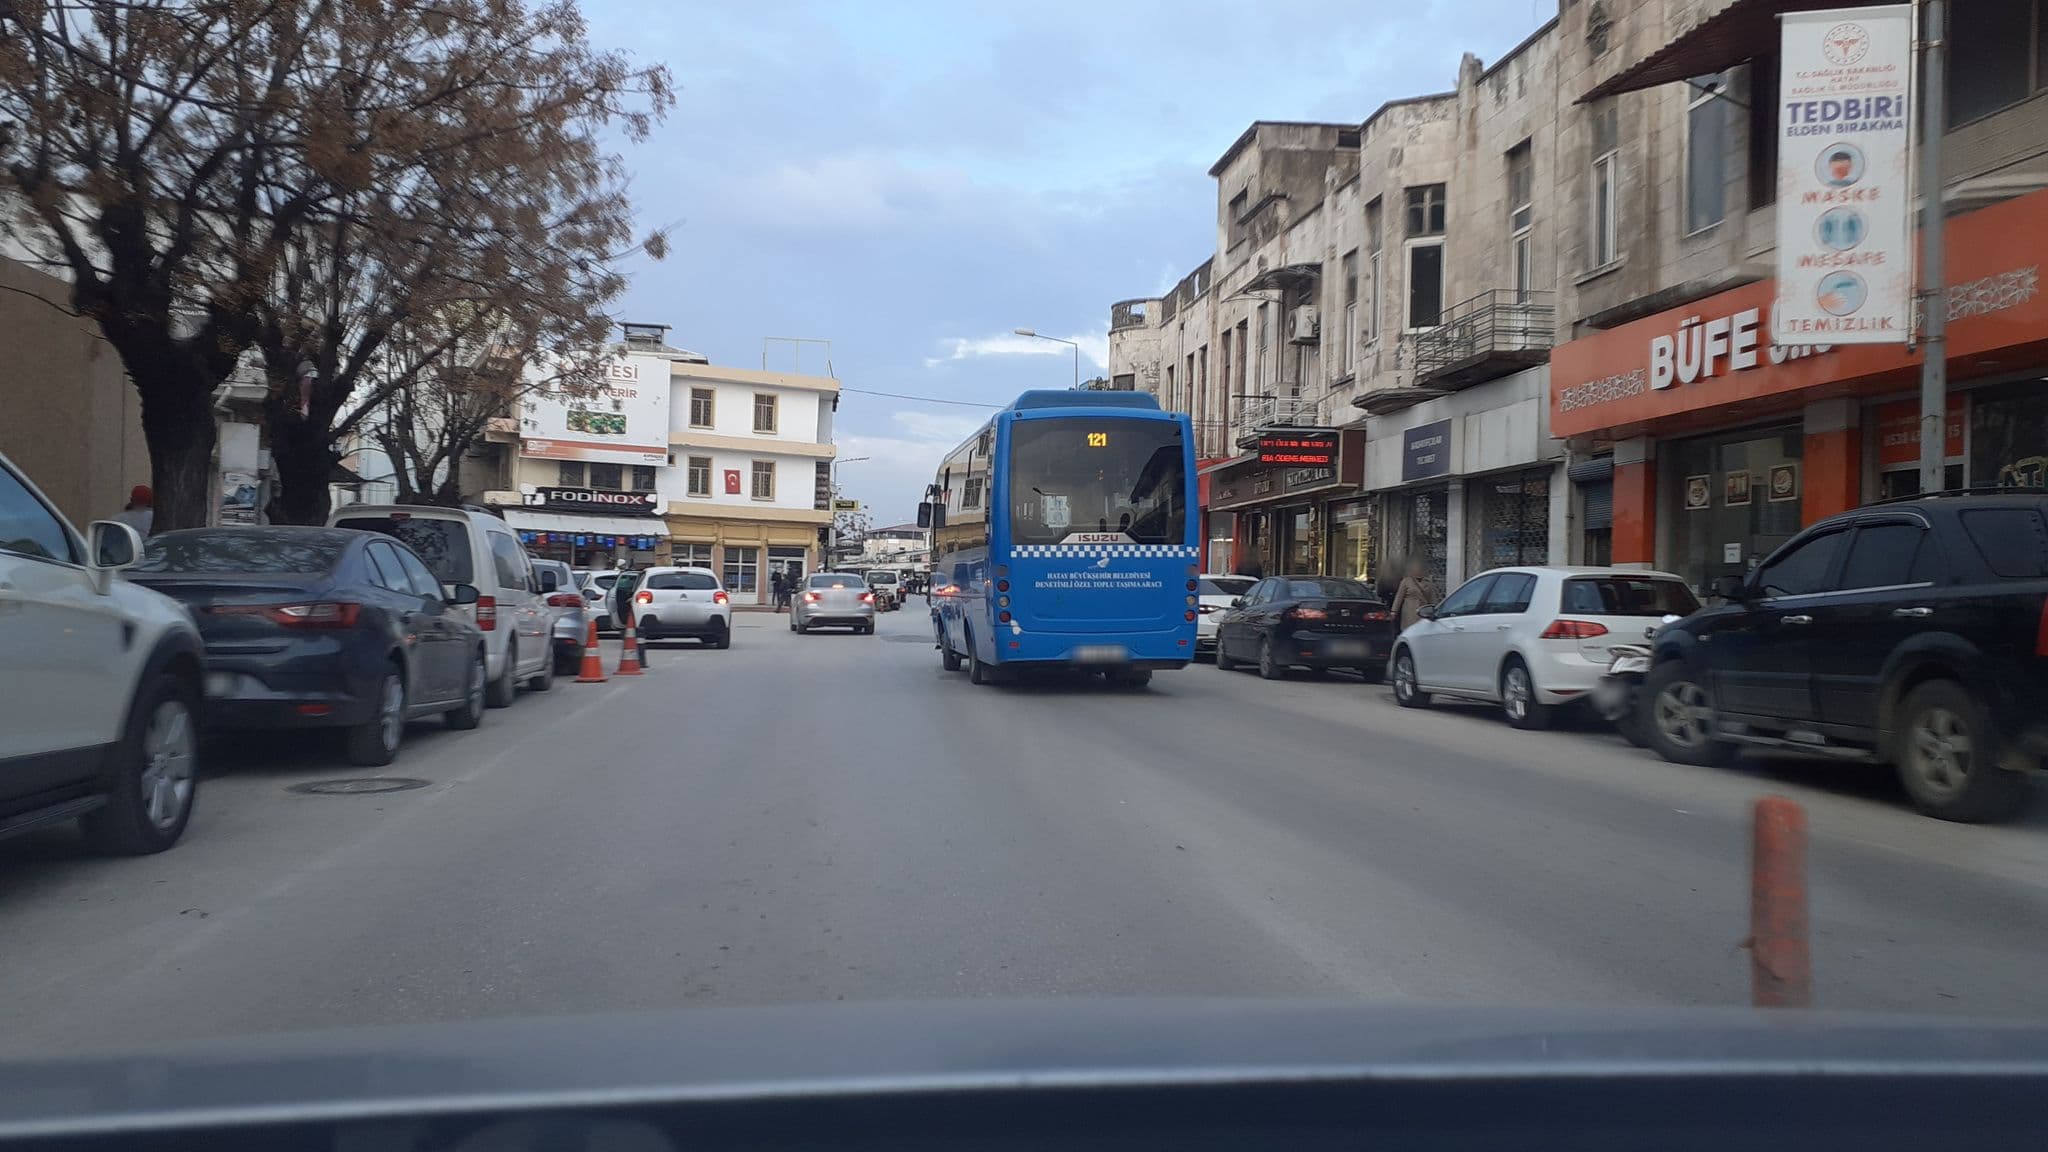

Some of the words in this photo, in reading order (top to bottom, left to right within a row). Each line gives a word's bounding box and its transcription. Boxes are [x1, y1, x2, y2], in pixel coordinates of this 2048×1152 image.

[1786, 124, 1831, 137] ELDEN
[1835, 120, 1904, 135] BIRAKMA
[1800, 187, 1881, 205] MASKE
[1796, 251, 1887, 268] MESAFE
[1651, 307, 1760, 391] BÜFE
[1086, 432, 1107, 447] 121
[1077, 533, 1120, 542] ISUZU
[1047, 572, 1068, 580] HATAY
[1074, 580, 1091, 588] ÖZEL
